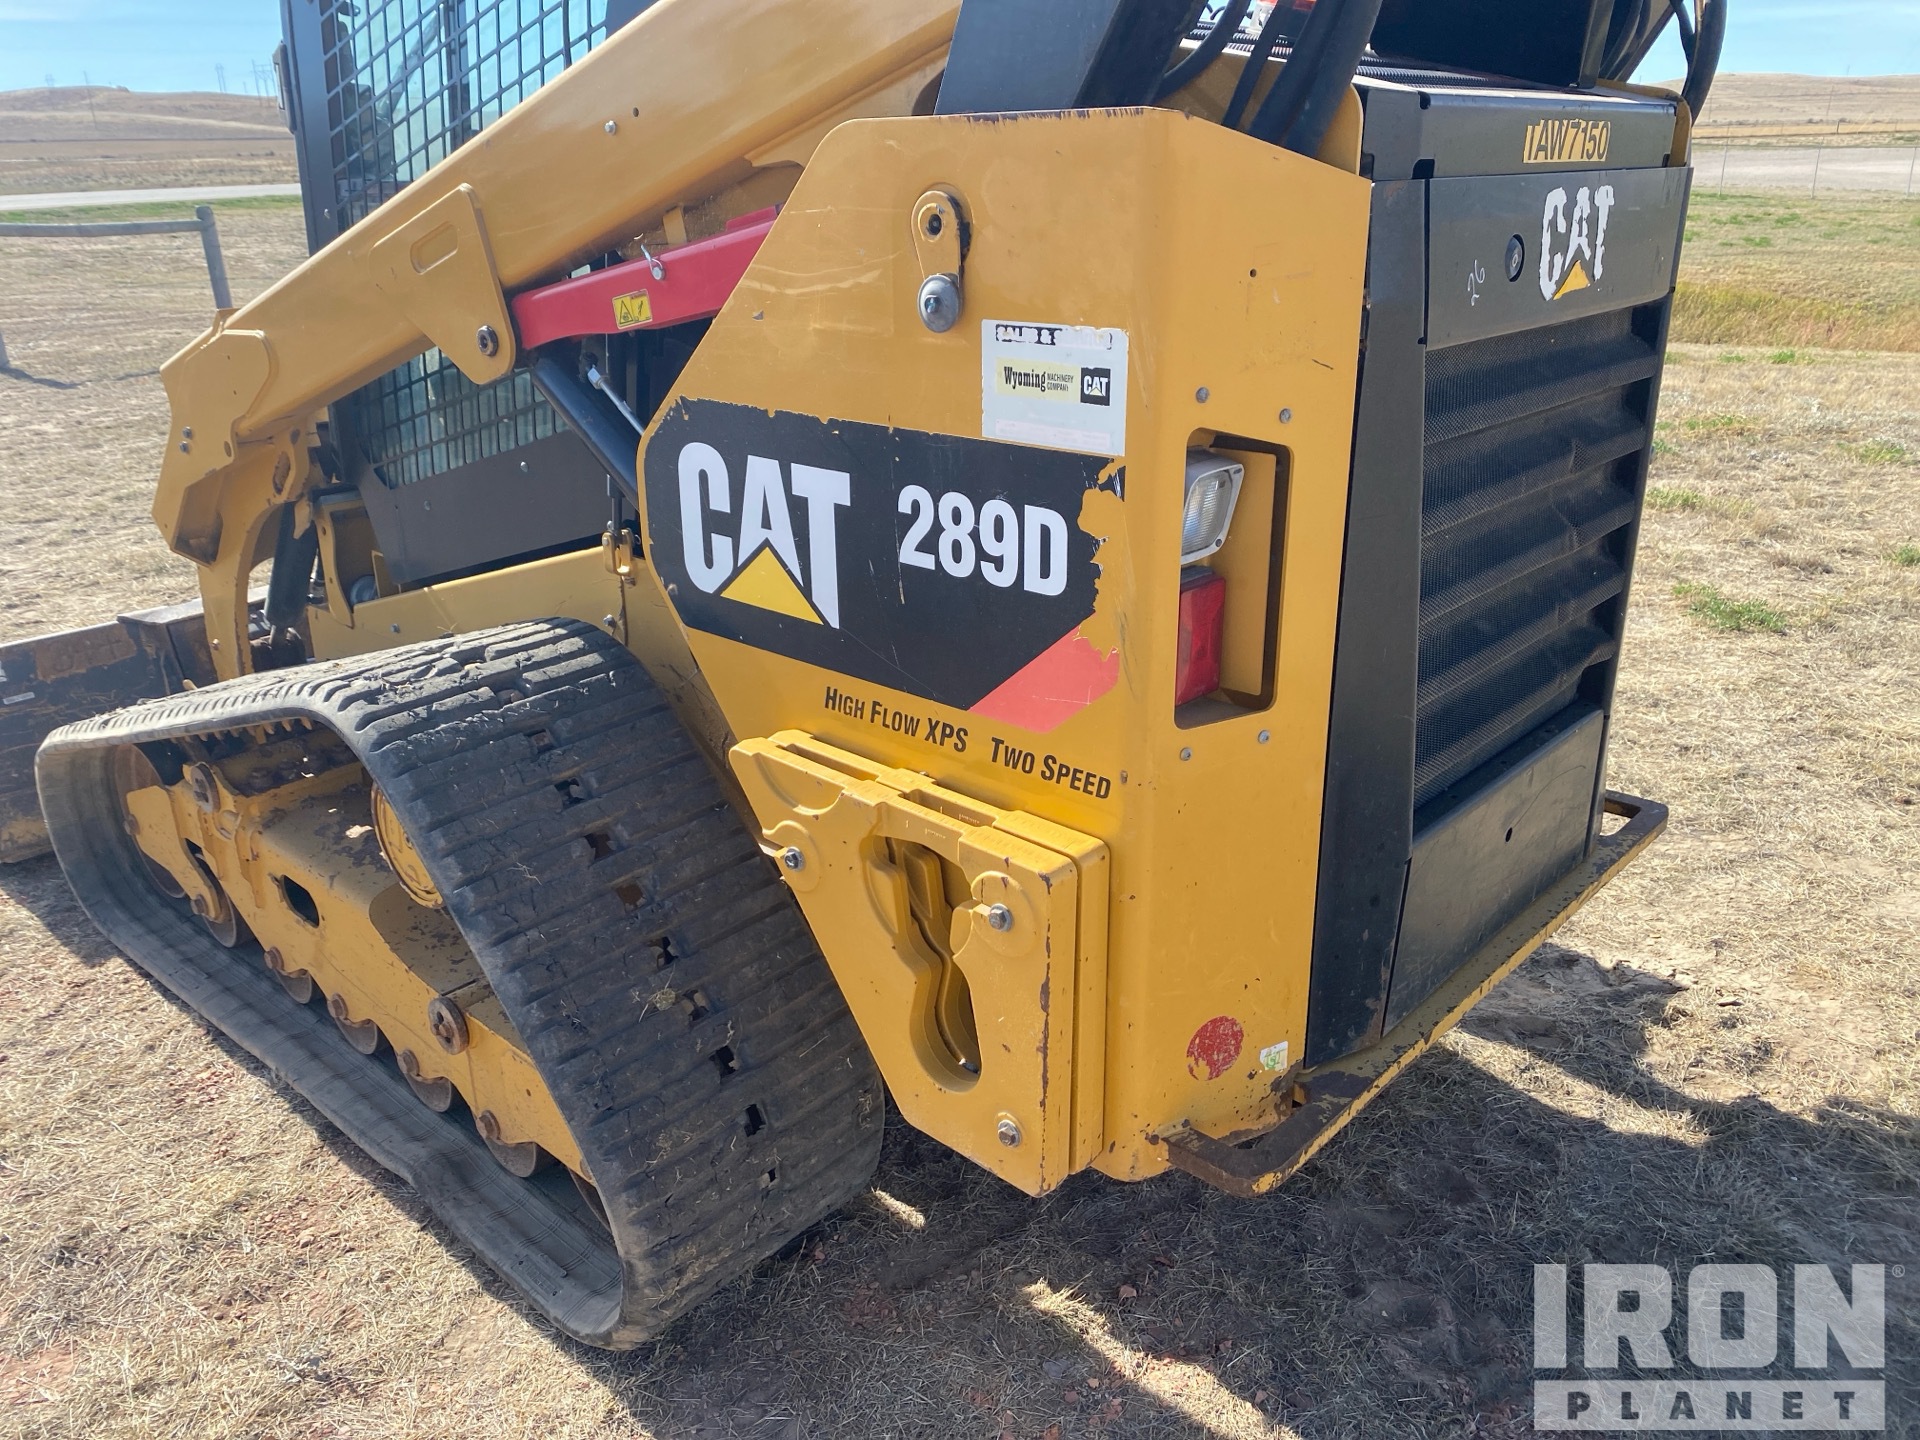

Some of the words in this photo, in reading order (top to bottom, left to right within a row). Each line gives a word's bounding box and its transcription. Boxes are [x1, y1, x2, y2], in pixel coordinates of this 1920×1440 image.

[1539, 185, 1615, 301] CAT
[1003, 366, 1046, 392] Wyoming
[1047, 373, 1074, 384] MACHINERY
[1047, 382, 1069, 392] COMPANY
[1083, 375, 1109, 397] CAT
[677, 441, 851, 630] CAT
[897, 484, 1069, 596] 289D
[824, 686, 864, 720] HIGH
[870, 700, 920, 737] FLOW
[924, 717, 969, 752] XPS
[991, 736, 1036, 774] TWO
[1040, 754, 1111, 799] SPEED
